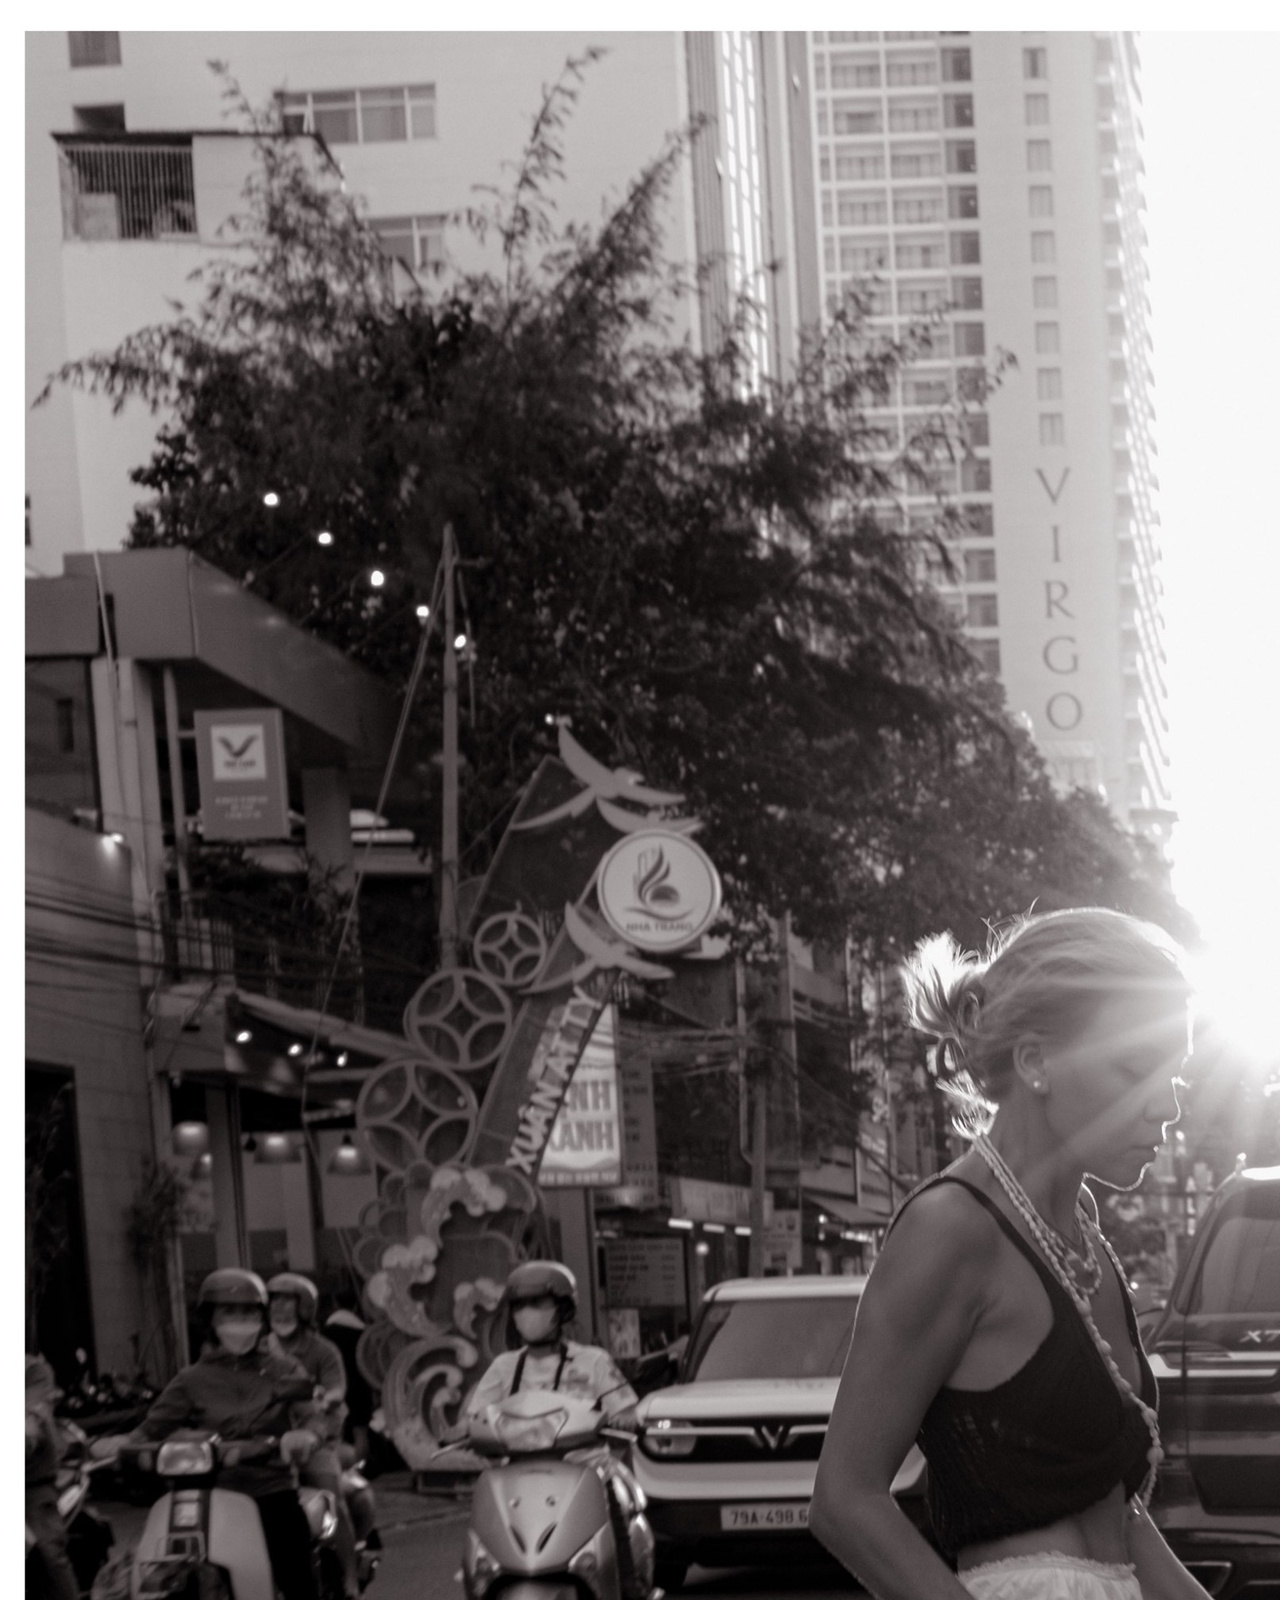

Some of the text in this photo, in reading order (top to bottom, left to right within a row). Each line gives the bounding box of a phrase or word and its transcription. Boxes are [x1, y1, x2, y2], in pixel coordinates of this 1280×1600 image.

[1034, 466, 1083, 731] VIRGO
[626, 922, 693, 931] NHA TRANG
